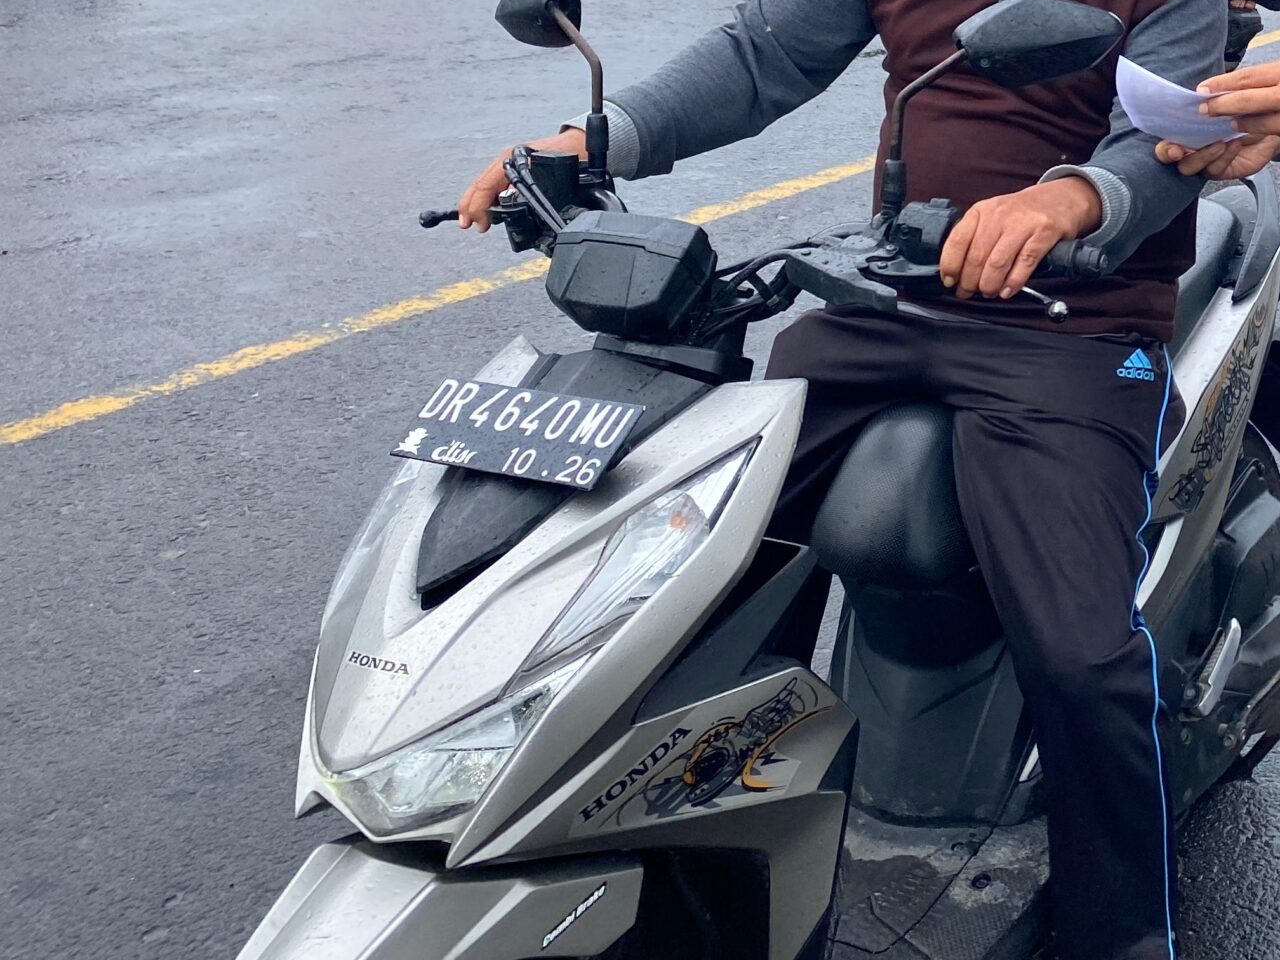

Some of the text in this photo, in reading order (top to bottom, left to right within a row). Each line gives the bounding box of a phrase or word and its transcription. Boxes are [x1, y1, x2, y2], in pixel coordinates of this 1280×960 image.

[1116, 366, 1154, 381] adidas
[348, 651, 410, 676] HONDA
[579, 727, 693, 823] HONDA
